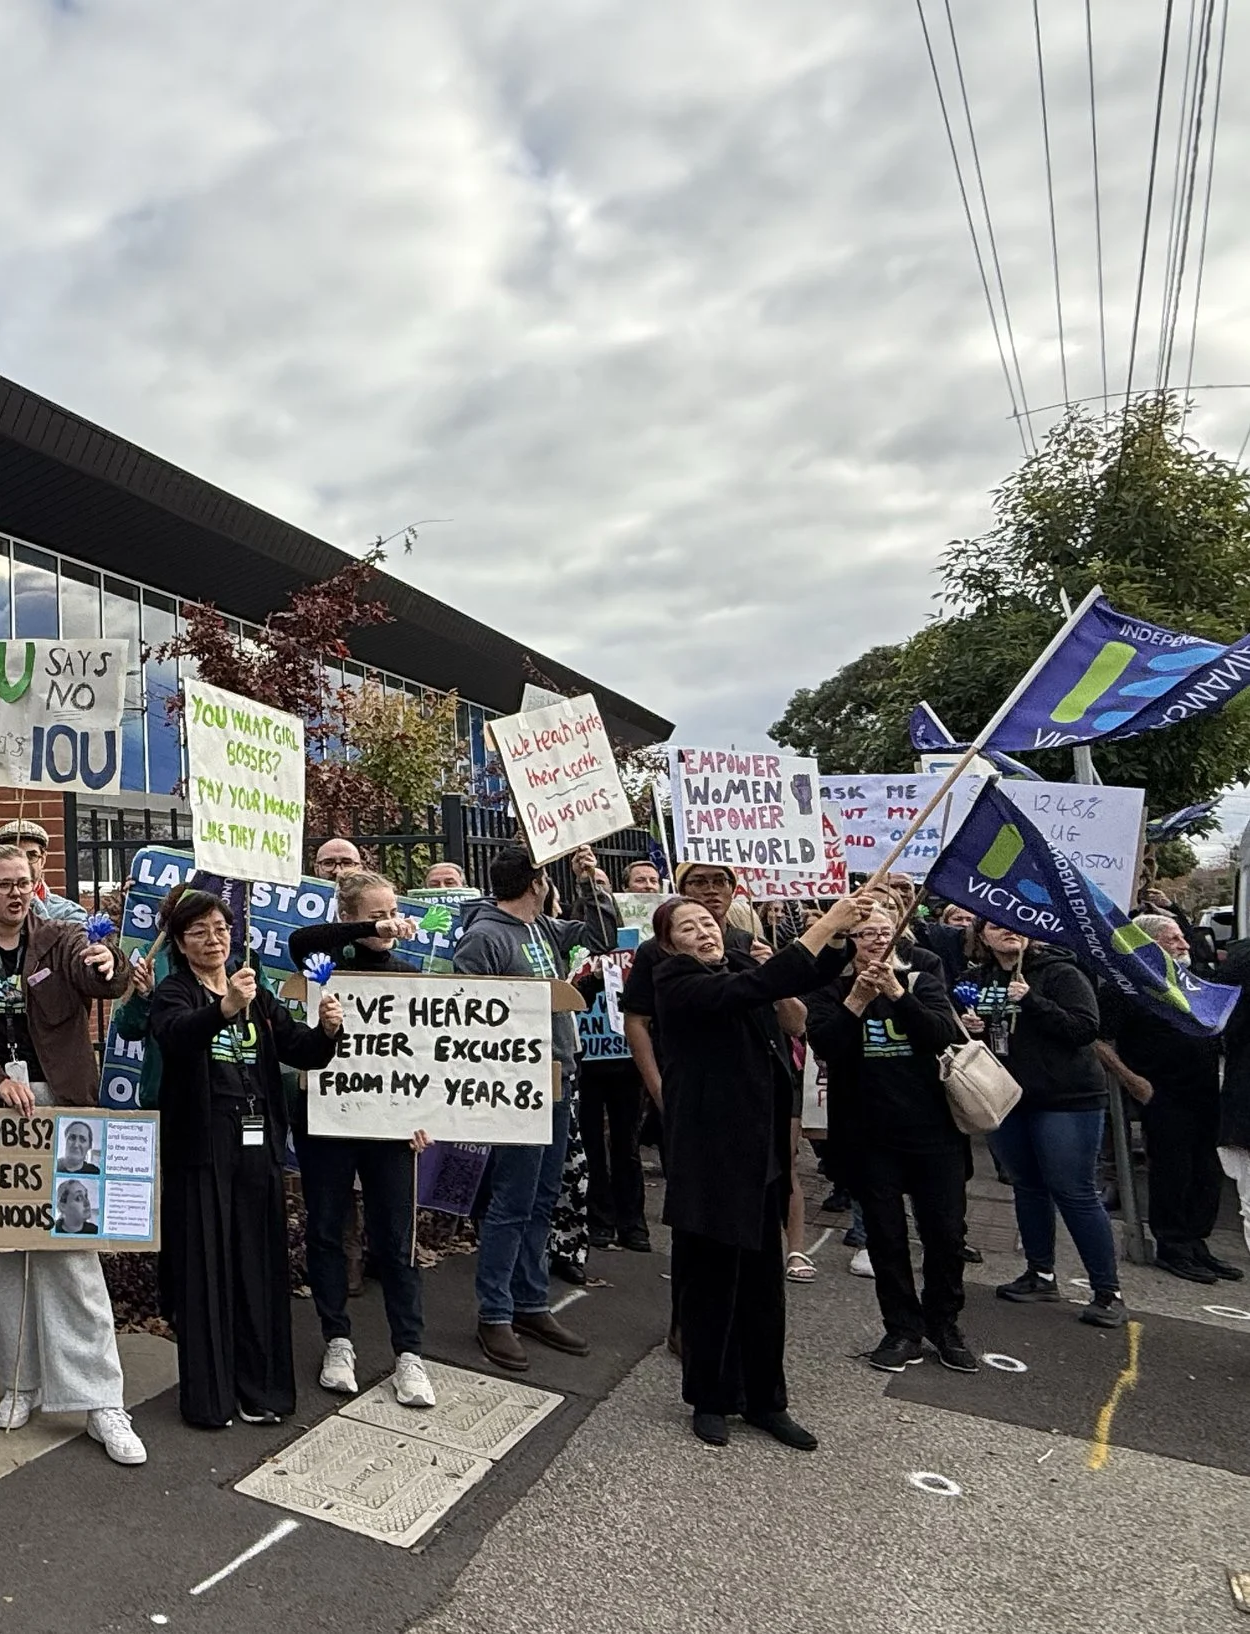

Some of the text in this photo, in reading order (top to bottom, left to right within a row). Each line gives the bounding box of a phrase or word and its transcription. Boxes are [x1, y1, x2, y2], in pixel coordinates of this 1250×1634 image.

[1119, 623, 1222, 648] INDEPEN
[45, 648, 112, 677] SAYS
[46, 680, 95, 711] NO
[192, 694, 300, 751] YOU WANT GIRL
[504, 713, 602, 758] We teach girls
[30, 724, 117, 790] IOU
[227, 740, 282, 782] BOSSES?
[683, 748, 781, 778] EMPOWER
[525, 764, 560, 788] their
[197, 776, 223, 805] PAY
[229, 784, 261, 812] YOUR
[820, 785, 917, 800] ASK ME
[526, 802, 558, 845] Pay
[558, 803, 575, 821] us
[686, 805, 785, 834] EMPOWER
[887, 807, 918, 821] MY
[228, 824, 256, 850] THEY
[262, 831, 291, 861] ARE!
[686, 837, 733, 862] THE
[737, 837, 815, 864] WORLD
[967, 876, 1064, 934] VICTORI
[334, 994, 395, 1025] 'VE
[409, 997, 510, 1028] HEARD
[336, 1033, 542, 1063] ETTER EXCUSES
[319, 1071, 383, 1096] FROM
[391, 1070, 429, 1098] MY
[444, 1078, 511, 1108] YEAR
